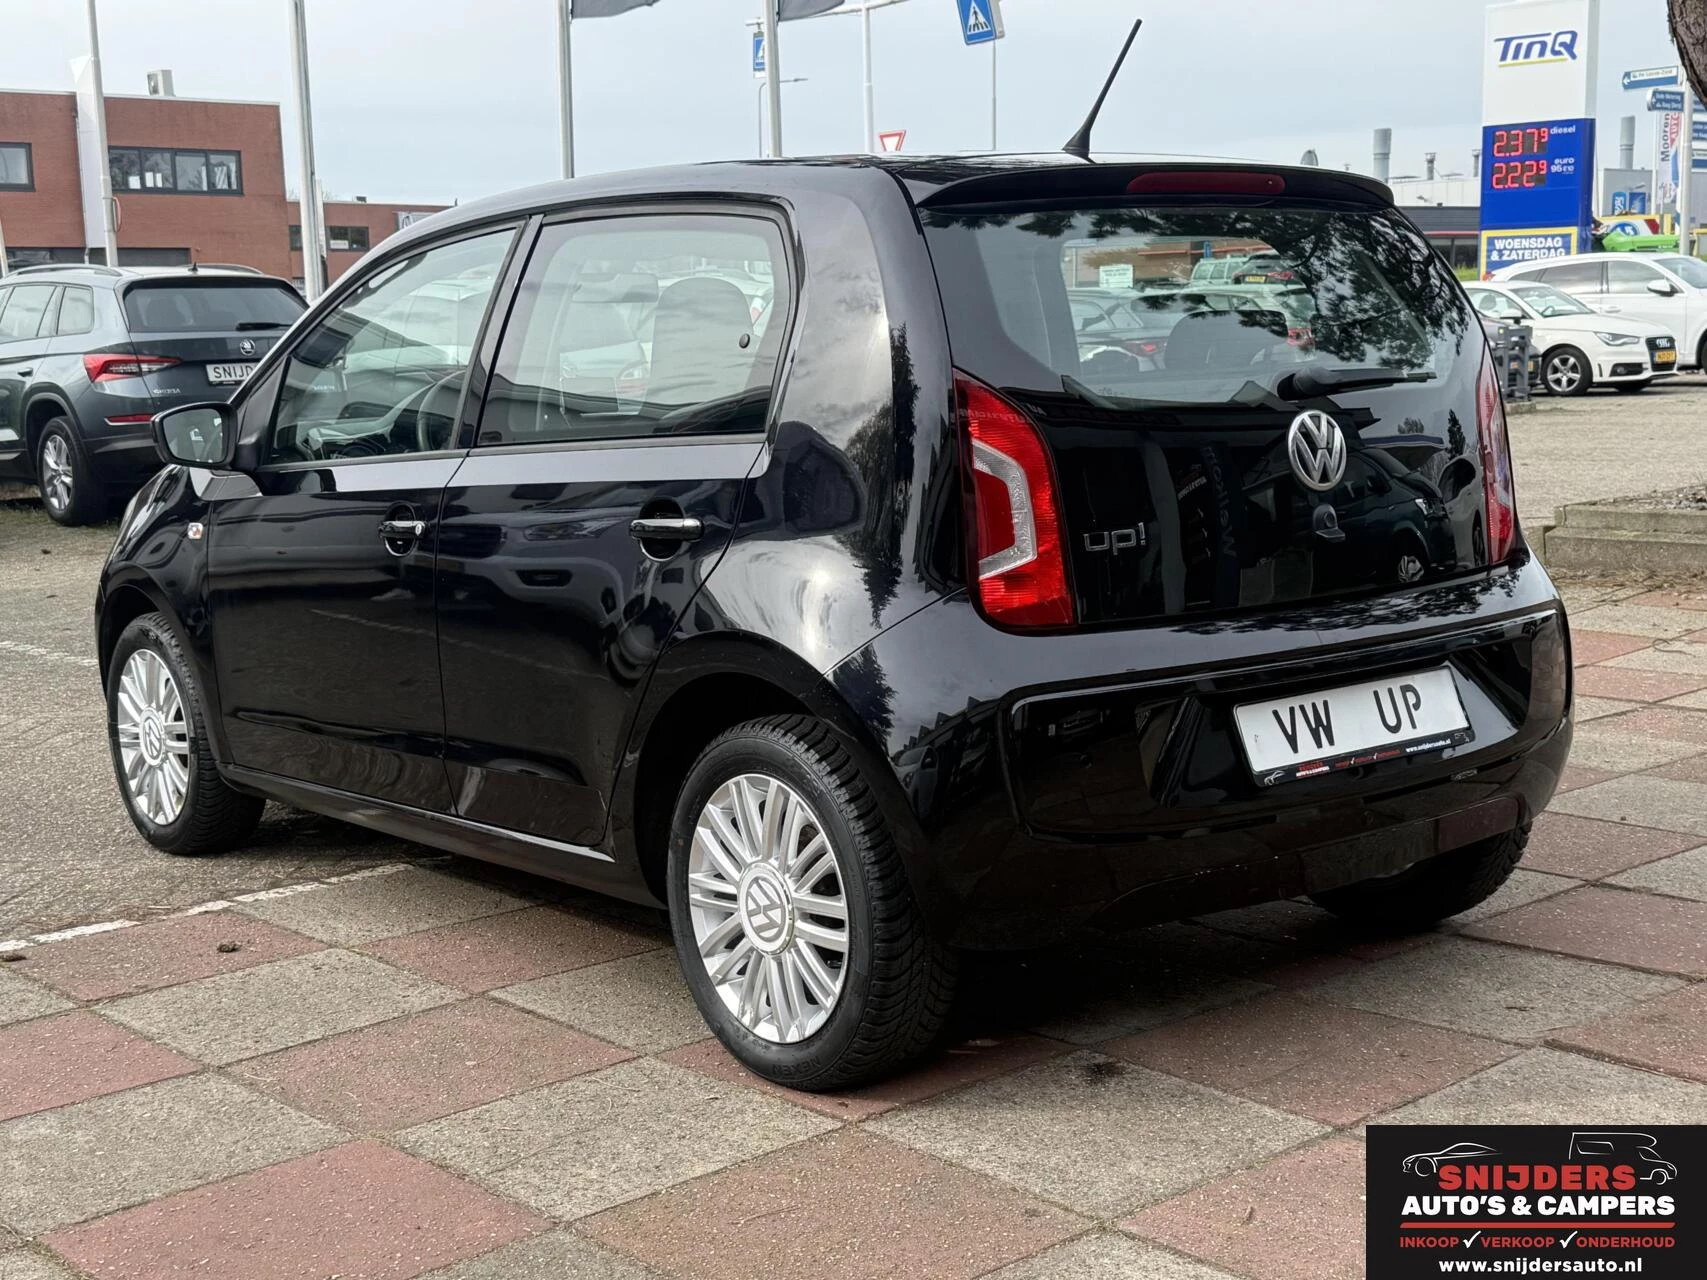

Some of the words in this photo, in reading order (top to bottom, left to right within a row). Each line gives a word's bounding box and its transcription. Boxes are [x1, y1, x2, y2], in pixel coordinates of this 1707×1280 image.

[1550, 125, 1576, 135] diesel
[1554, 157, 1575, 165] euro
[1494, 237, 1563, 250] WOENSDAG
[1490, 250, 1500, 261] &
[1502, 247, 1566, 260] ZATERDAG
[1083, 522, 1146, 556] up!
[1271, 699, 1336, 754] VW
[1373, 683, 1422, 734] UP
